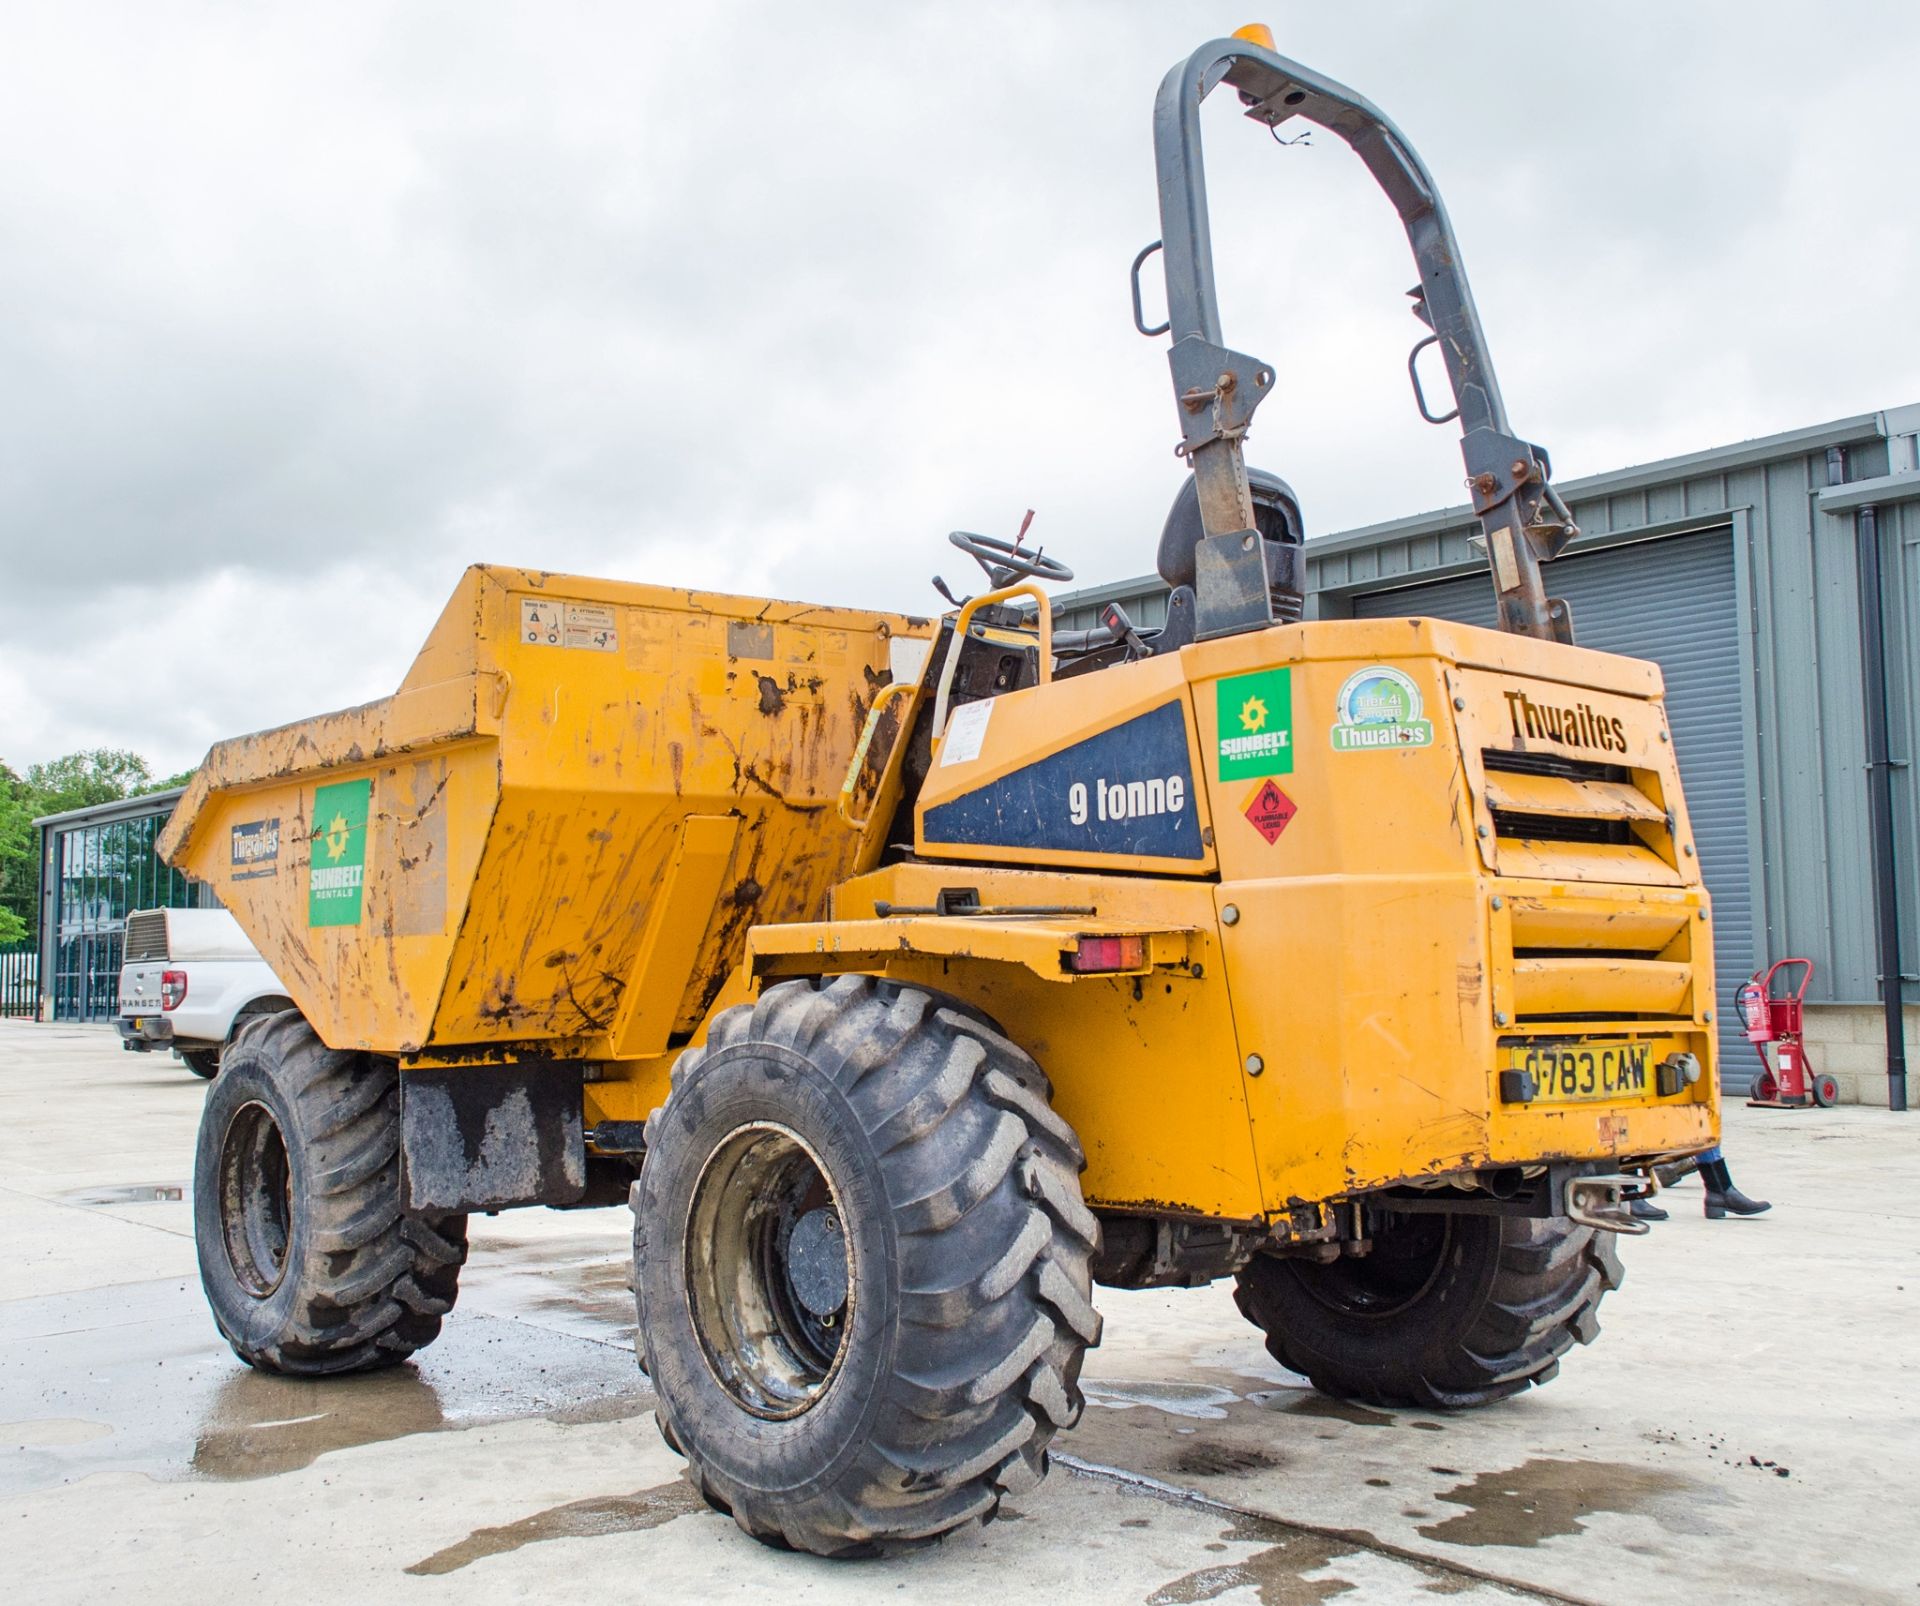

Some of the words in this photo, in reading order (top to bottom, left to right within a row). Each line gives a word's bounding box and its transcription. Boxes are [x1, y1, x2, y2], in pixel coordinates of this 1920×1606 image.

[1358, 696, 1386, 707] Tier
[1503, 690, 1627, 754] Thwaites
[1220, 730, 1288, 755] SUNBELT
[1338, 724, 1425, 747] Thwaites
[1229, 748, 1279, 761] RENTALS
[1069, 782, 1088, 825] 9
[1097, 775, 1184, 821] tonne
[1254, 812, 1288, 823] FLAMMABLE
[1263, 821, 1281, 829] LIQUID
[1269, 831, 1275, 839] 3
[310, 864, 363, 891] SUNBELT
[315, 888, 354, 899] RENTALS
[1602, 1048, 1646, 1092] CAW
